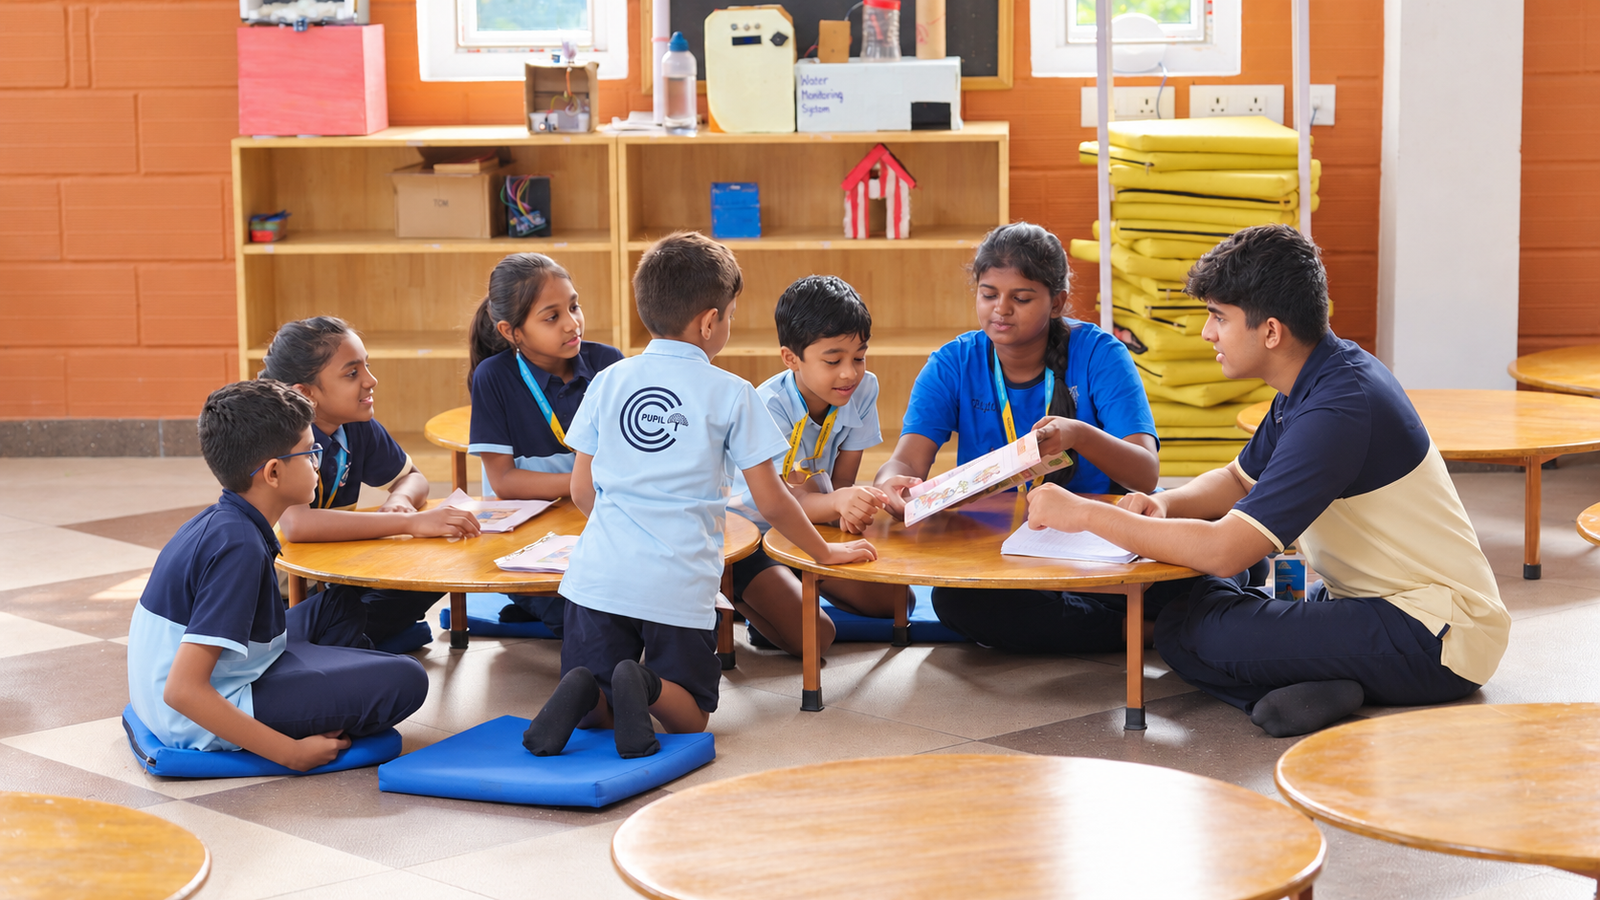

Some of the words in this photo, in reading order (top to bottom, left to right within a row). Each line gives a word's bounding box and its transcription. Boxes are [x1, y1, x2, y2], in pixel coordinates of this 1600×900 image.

[800, 74, 828, 86] Water
[801, 89, 844, 103] Monitoring
[641, 413, 666, 424] PUPIL
